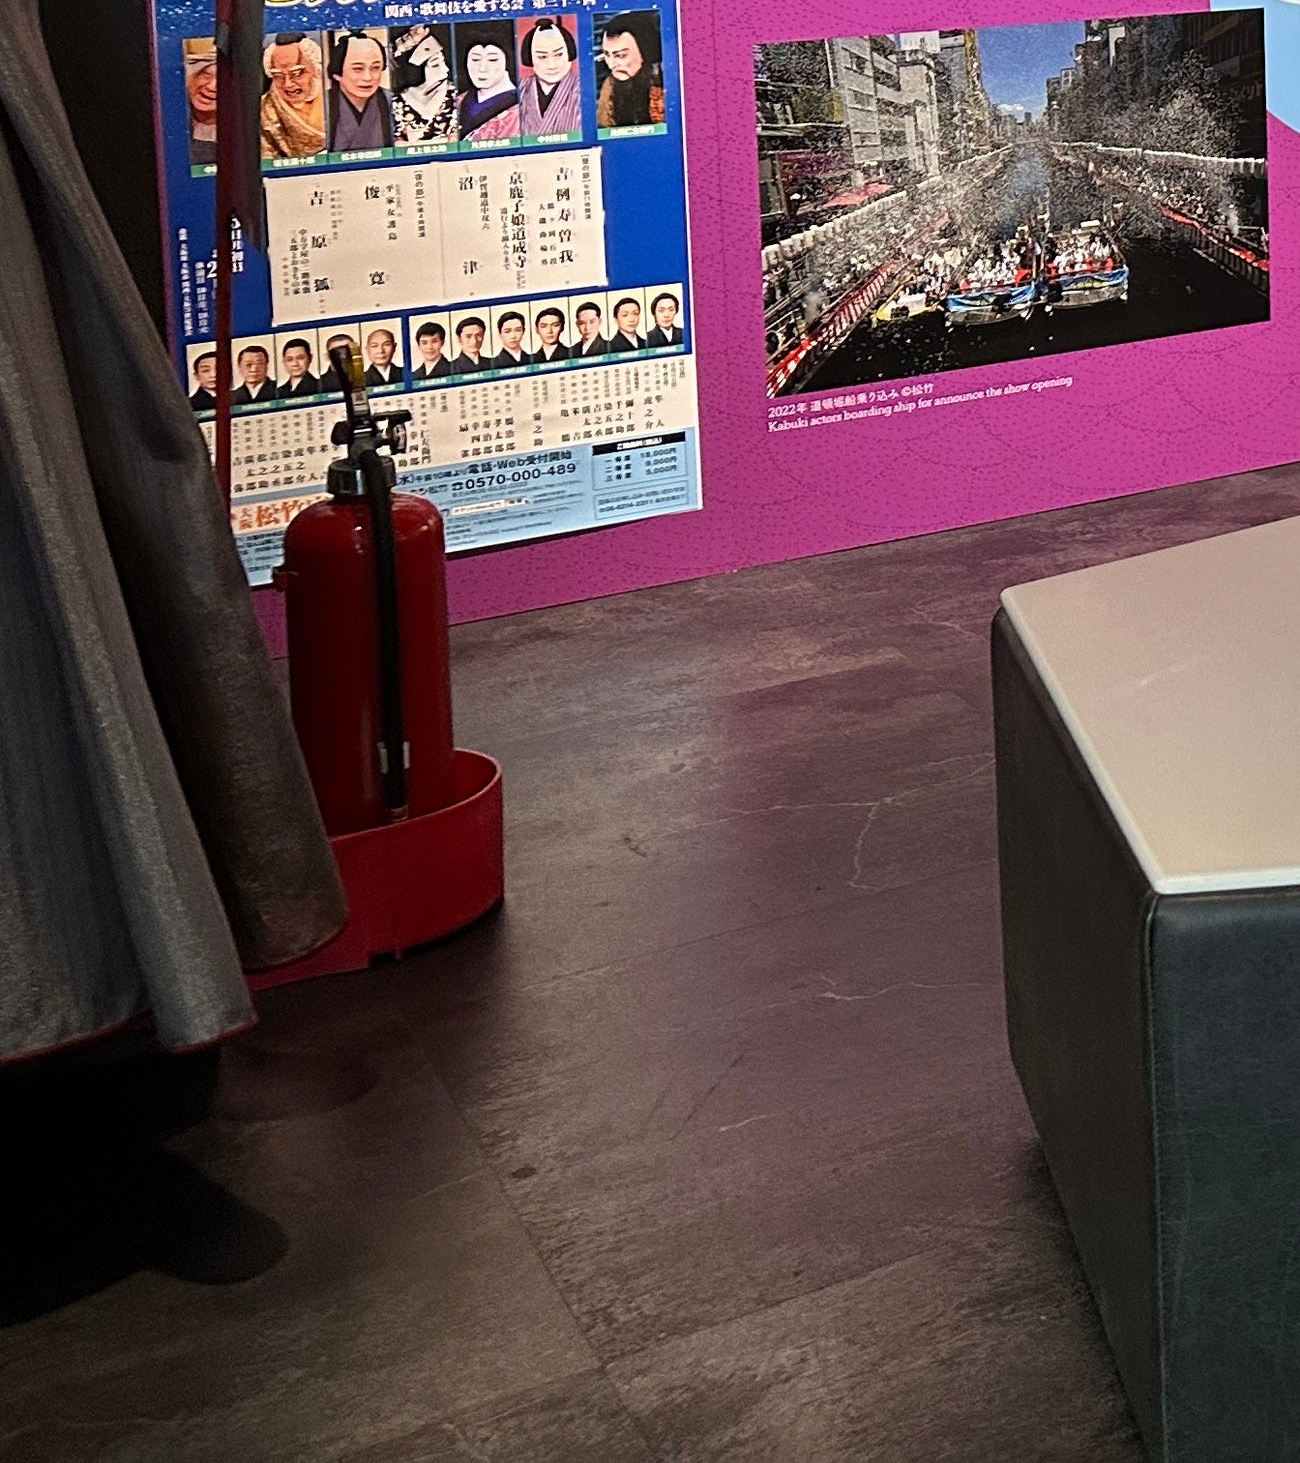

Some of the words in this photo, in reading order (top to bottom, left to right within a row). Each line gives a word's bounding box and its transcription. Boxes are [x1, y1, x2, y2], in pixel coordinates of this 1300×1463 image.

[768, 416, 809, 433] Kabuki
[810, 412, 842, 426] actors
[843, 403, 892, 422] boarding
[893, 399, 915, 414] ship
[917, 397, 933, 410] for
[934, 390, 984, 407] announce
[985, 385, 1002, 399] the
[1003, 382, 1030, 396] show
[1031, 375, 1073, 392] opening
[465, 463, 576, 490] 0570-000-489
